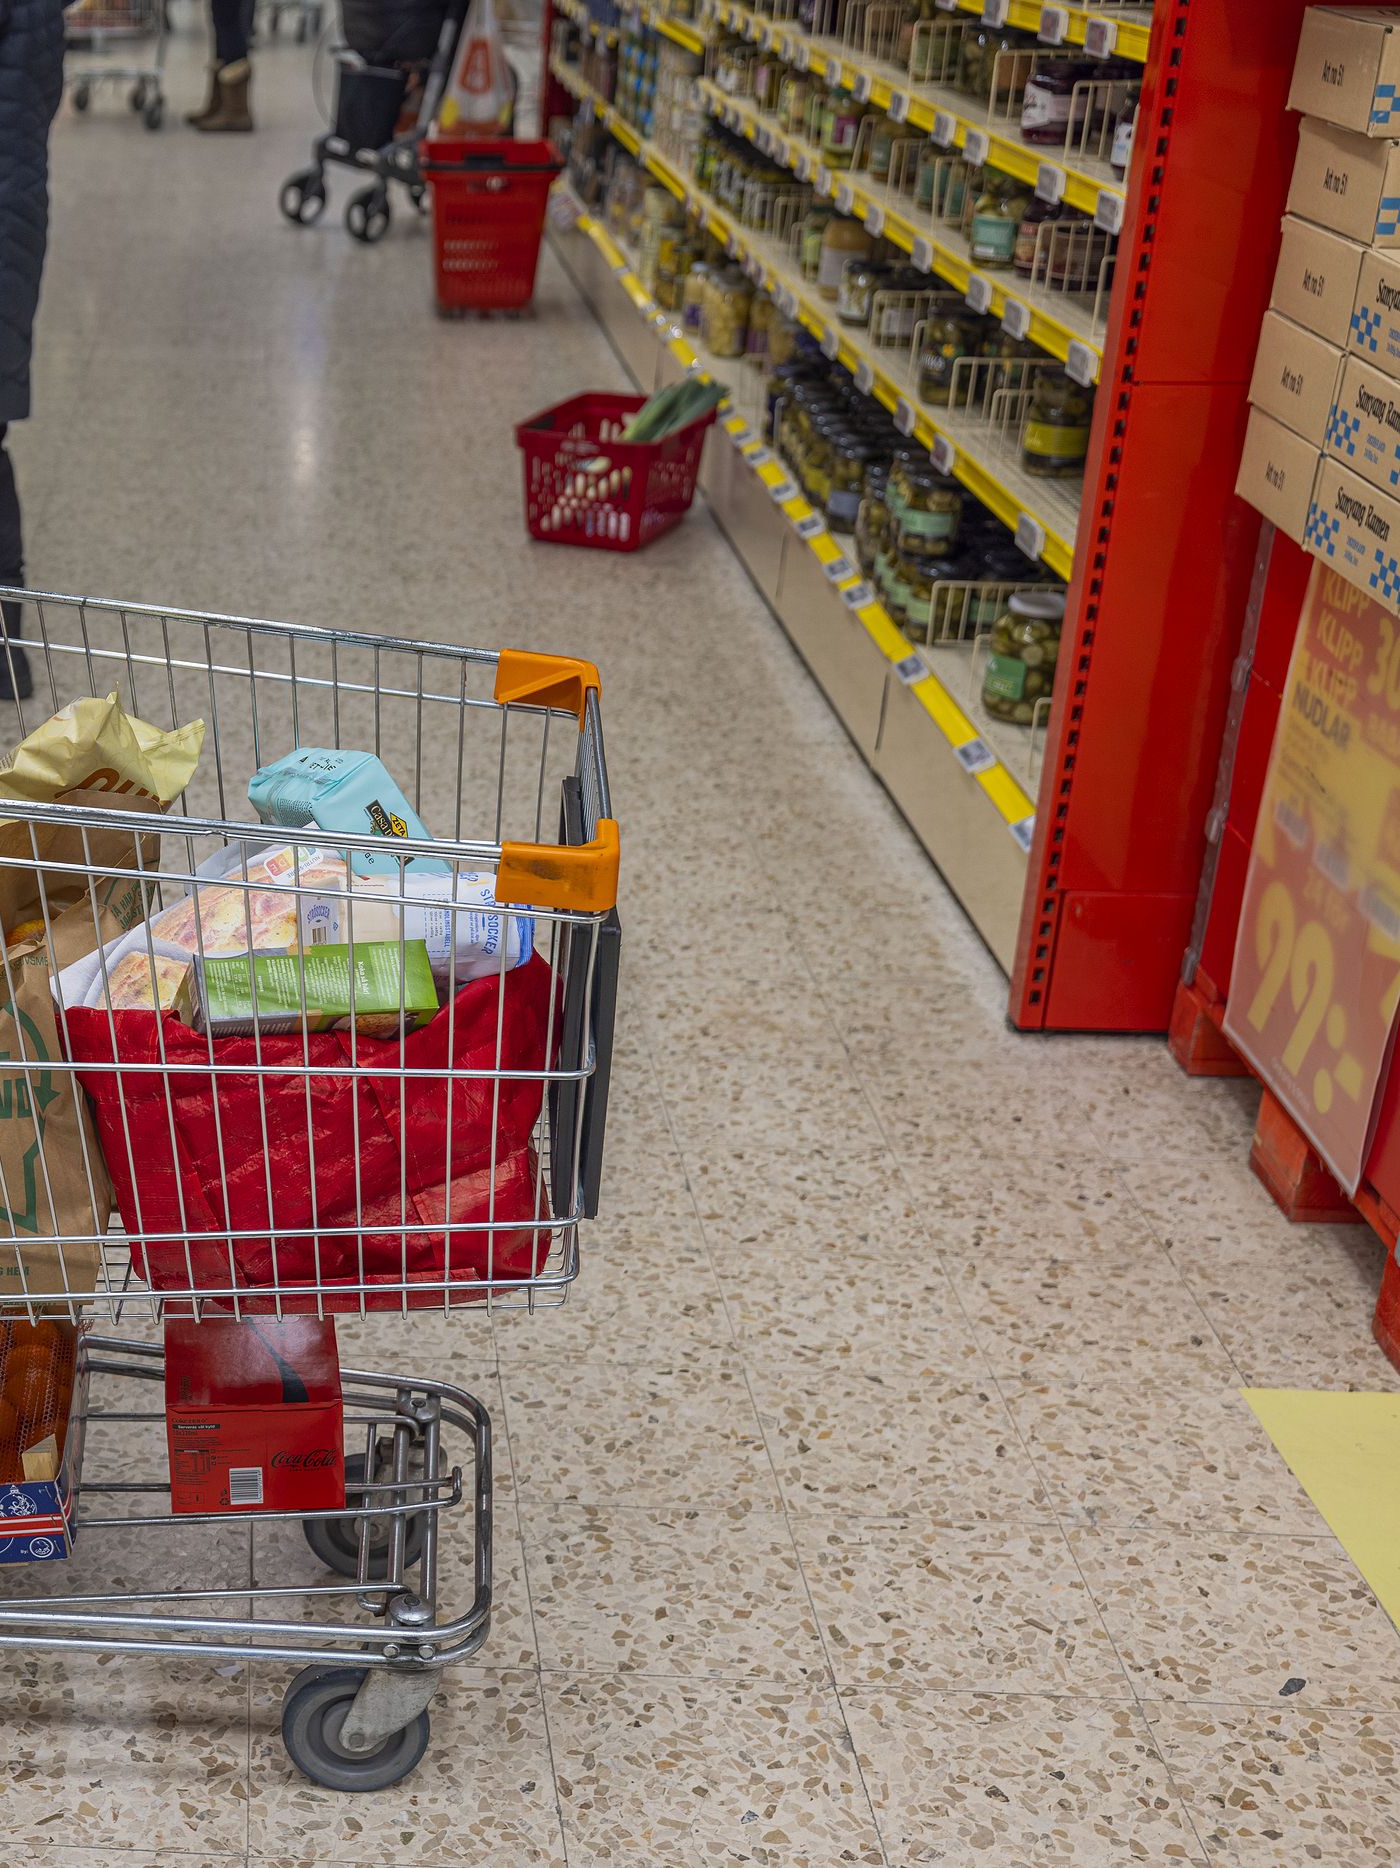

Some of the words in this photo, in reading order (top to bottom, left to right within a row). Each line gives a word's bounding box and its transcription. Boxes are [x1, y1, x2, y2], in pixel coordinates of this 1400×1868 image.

[1365, 504, 1390, 541] Ramen
[1316, 607, 1364, 672] KLIPP
[1291, 679, 1350, 752] NUDLAR
[371, 805, 388, 832] Casa
[393, 817, 406, 836] ZETA
[480, 887, 499, 956] STRSOCKER
